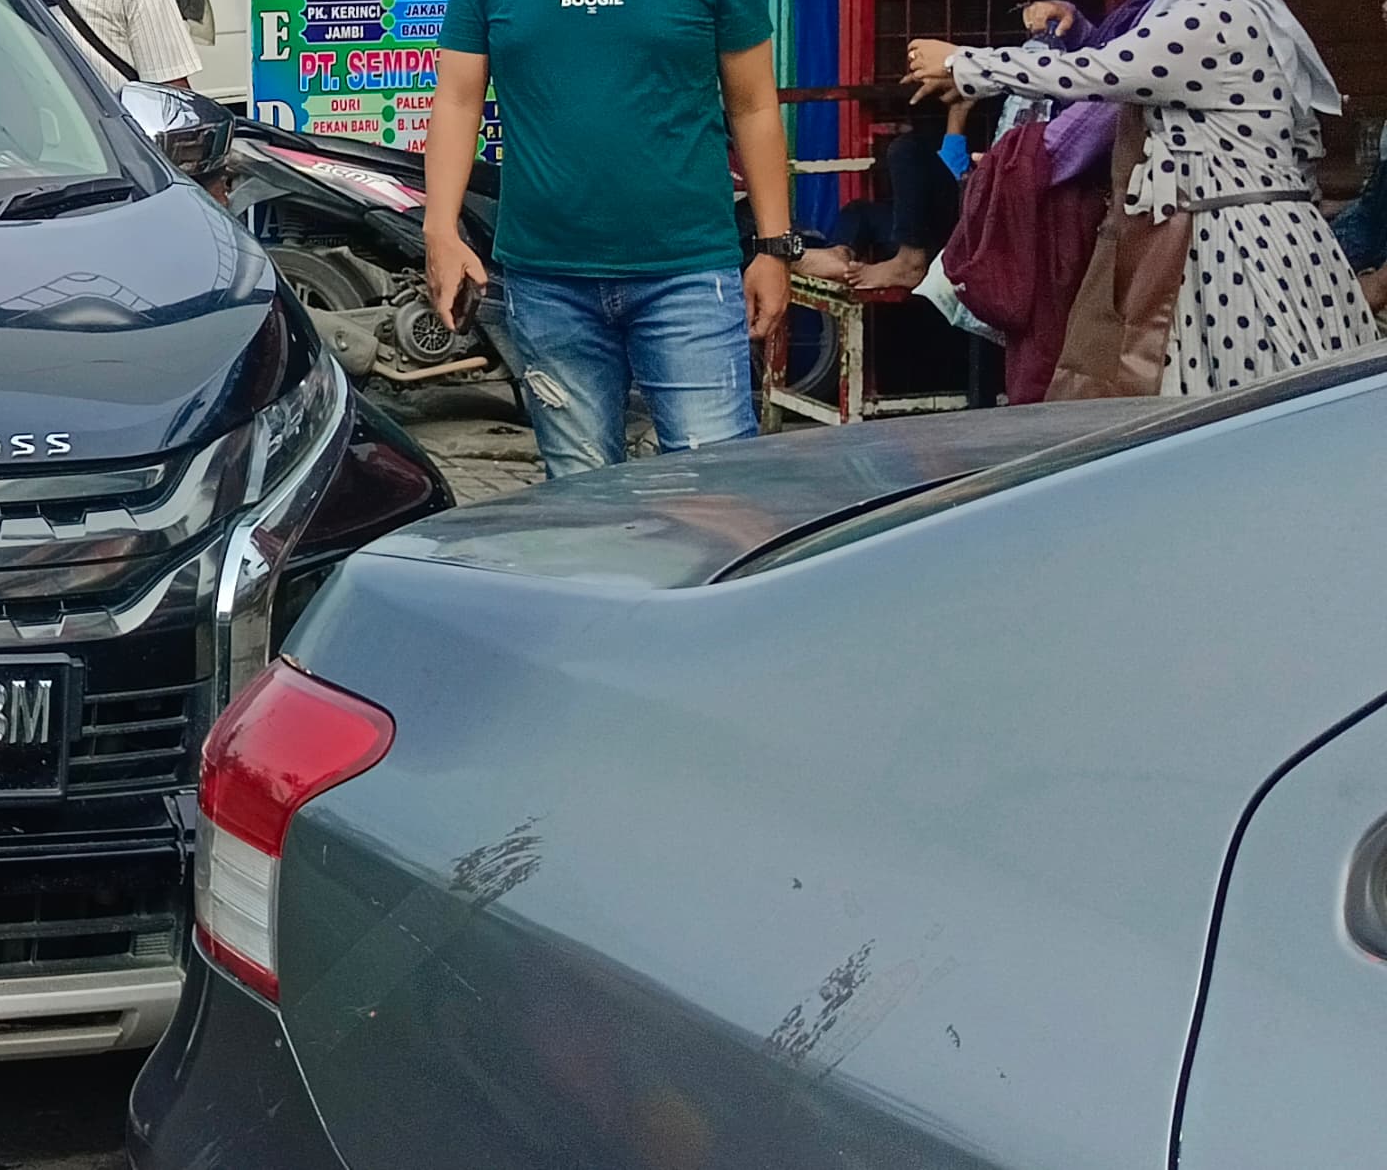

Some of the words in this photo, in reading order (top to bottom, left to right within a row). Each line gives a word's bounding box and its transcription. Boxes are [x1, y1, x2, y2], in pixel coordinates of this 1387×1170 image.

[308, 7, 327, 19] PK.
[331, 6, 381, 18] KERINCI
[325, 26, 364, 39] JAMBI
[299, 51, 339, 91] PT.
[331, 99, 360, 112] DURI
[313, 120, 348, 134] PEKAN
[351, 119, 379, 132] BARU
[398, 118, 409, 130] B.
